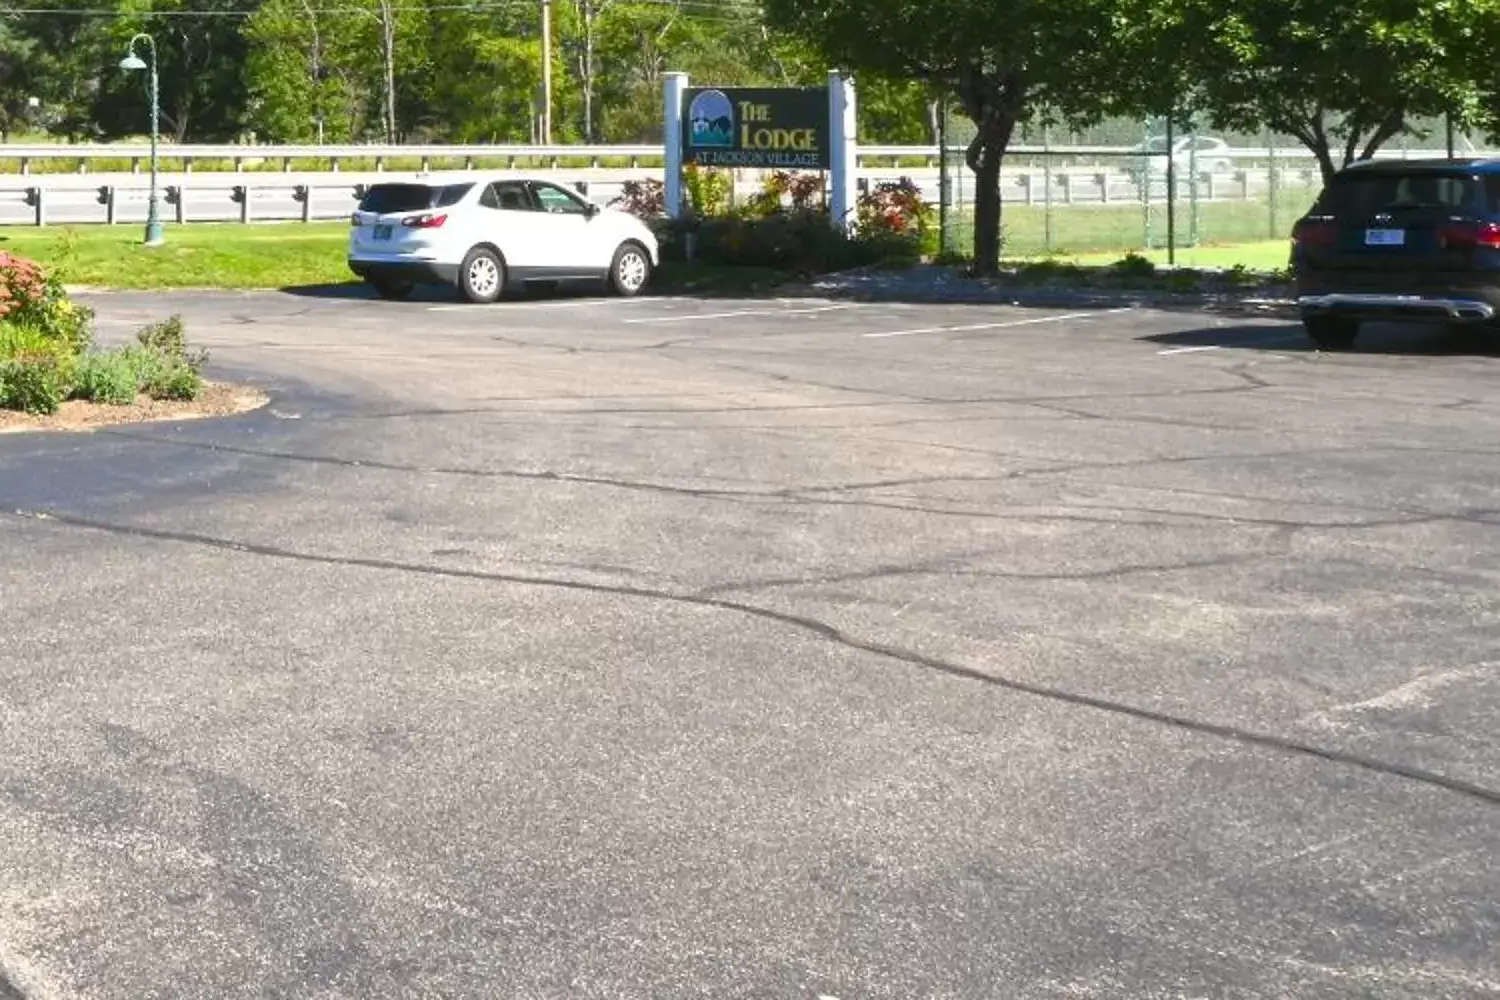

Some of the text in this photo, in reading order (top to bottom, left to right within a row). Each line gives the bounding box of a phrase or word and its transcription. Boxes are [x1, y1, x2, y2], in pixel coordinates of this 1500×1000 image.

[738, 101, 772, 121] THE
[740, 124, 819, 150] LODGE
[767, 152, 820, 165] VILLAGE
